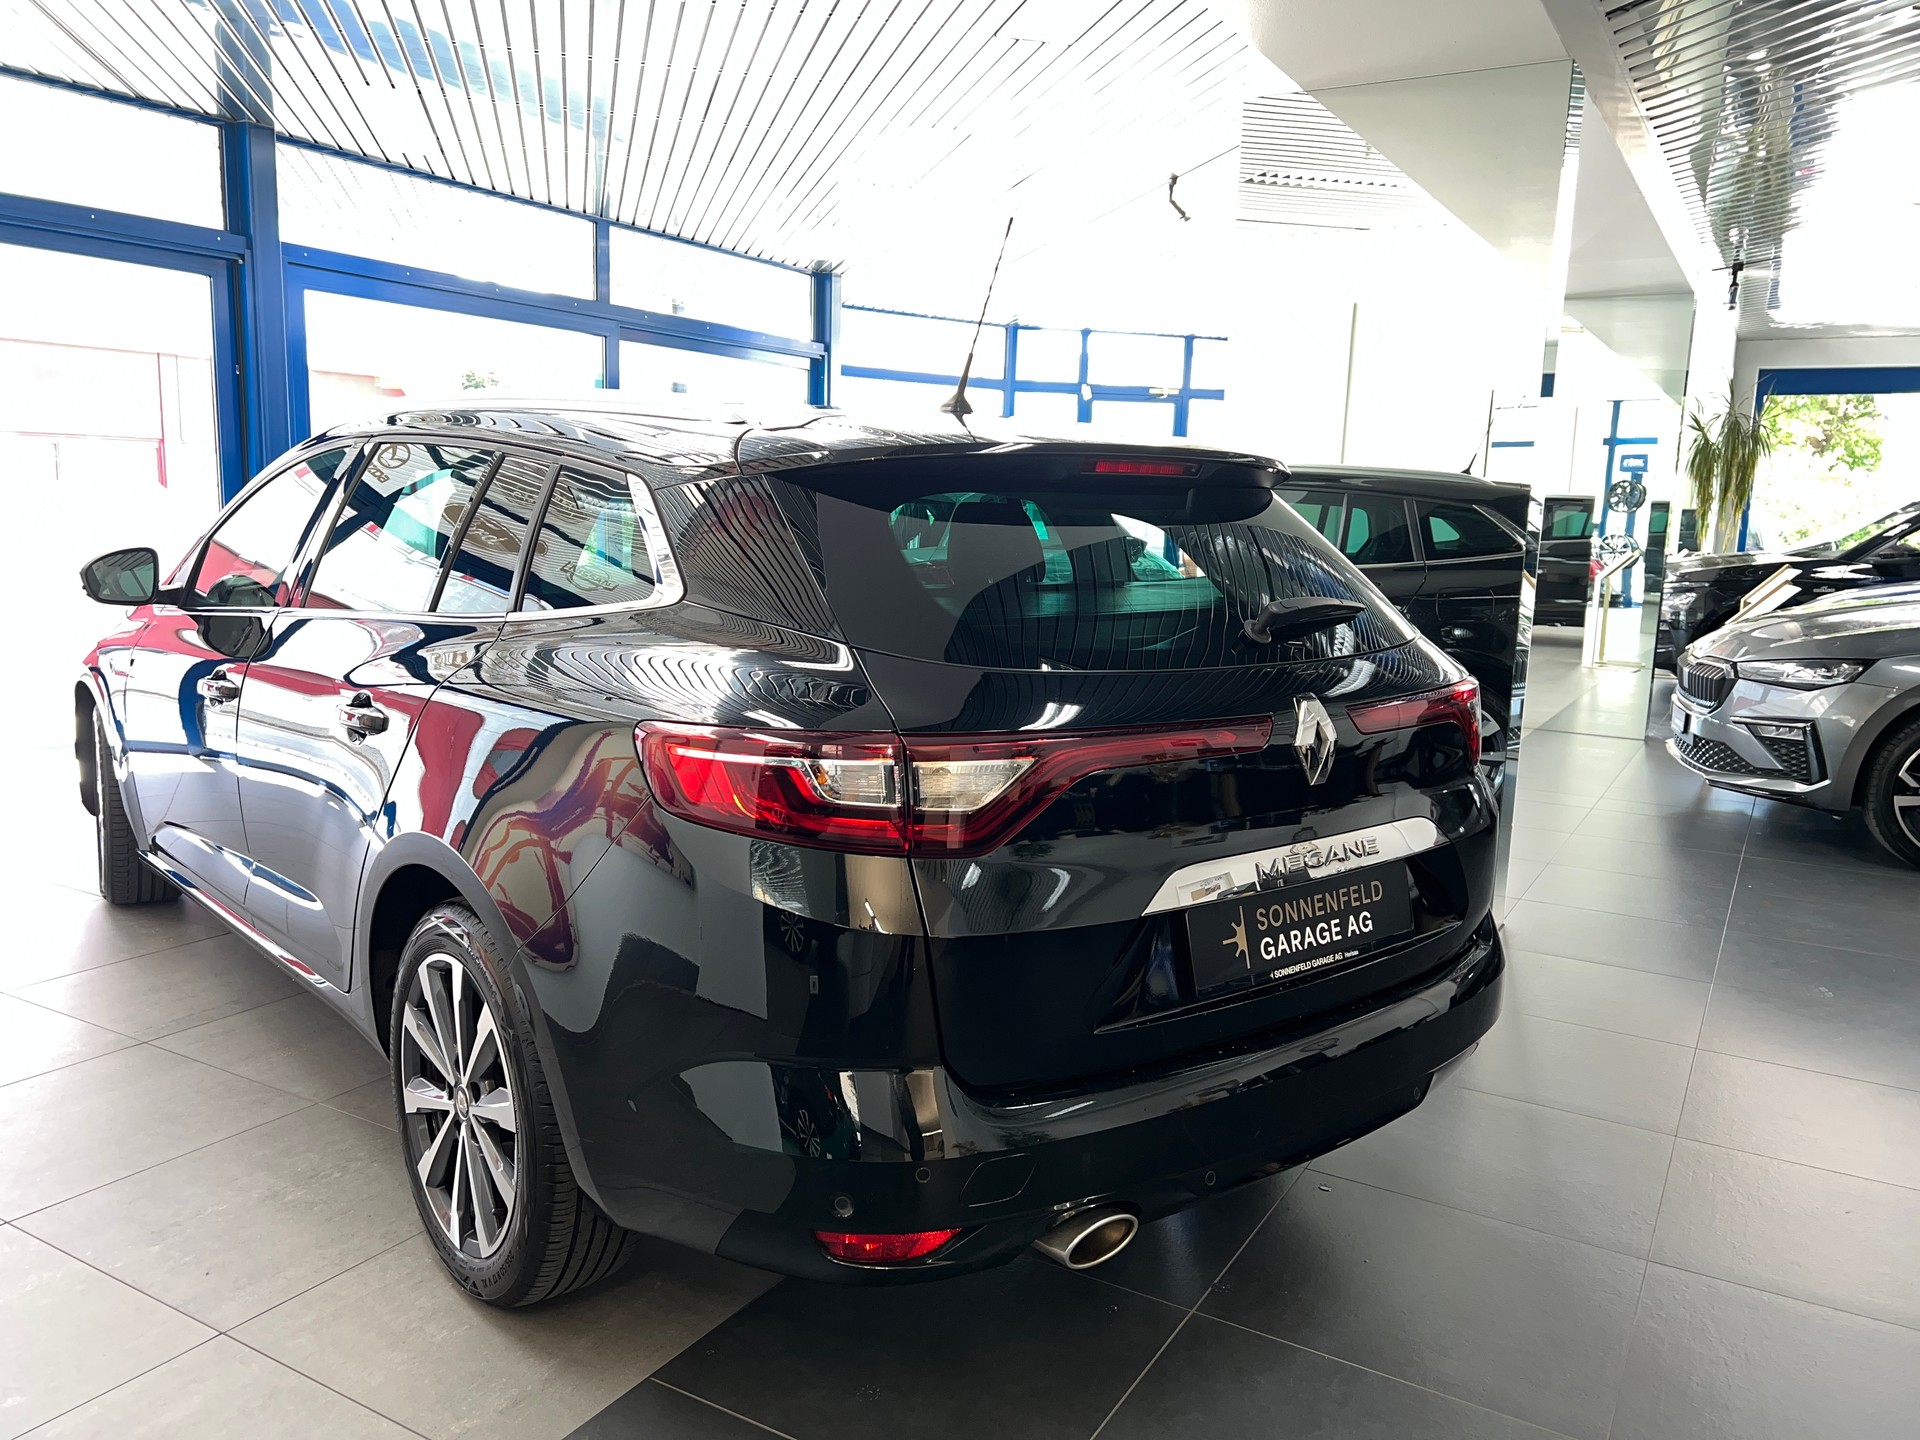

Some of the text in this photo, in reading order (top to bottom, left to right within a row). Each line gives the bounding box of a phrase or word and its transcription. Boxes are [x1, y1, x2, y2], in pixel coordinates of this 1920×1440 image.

[1255, 836, 1380, 881] MEGANE
[1256, 880, 1384, 931] SONNENFELD
[1260, 910, 1374, 960] GARAGE AG
[1274, 961, 1312, 978] SONNENFELD
[1311, 954, 1335, 968] GARAGE
[1334, 952, 1343, 961] AG
